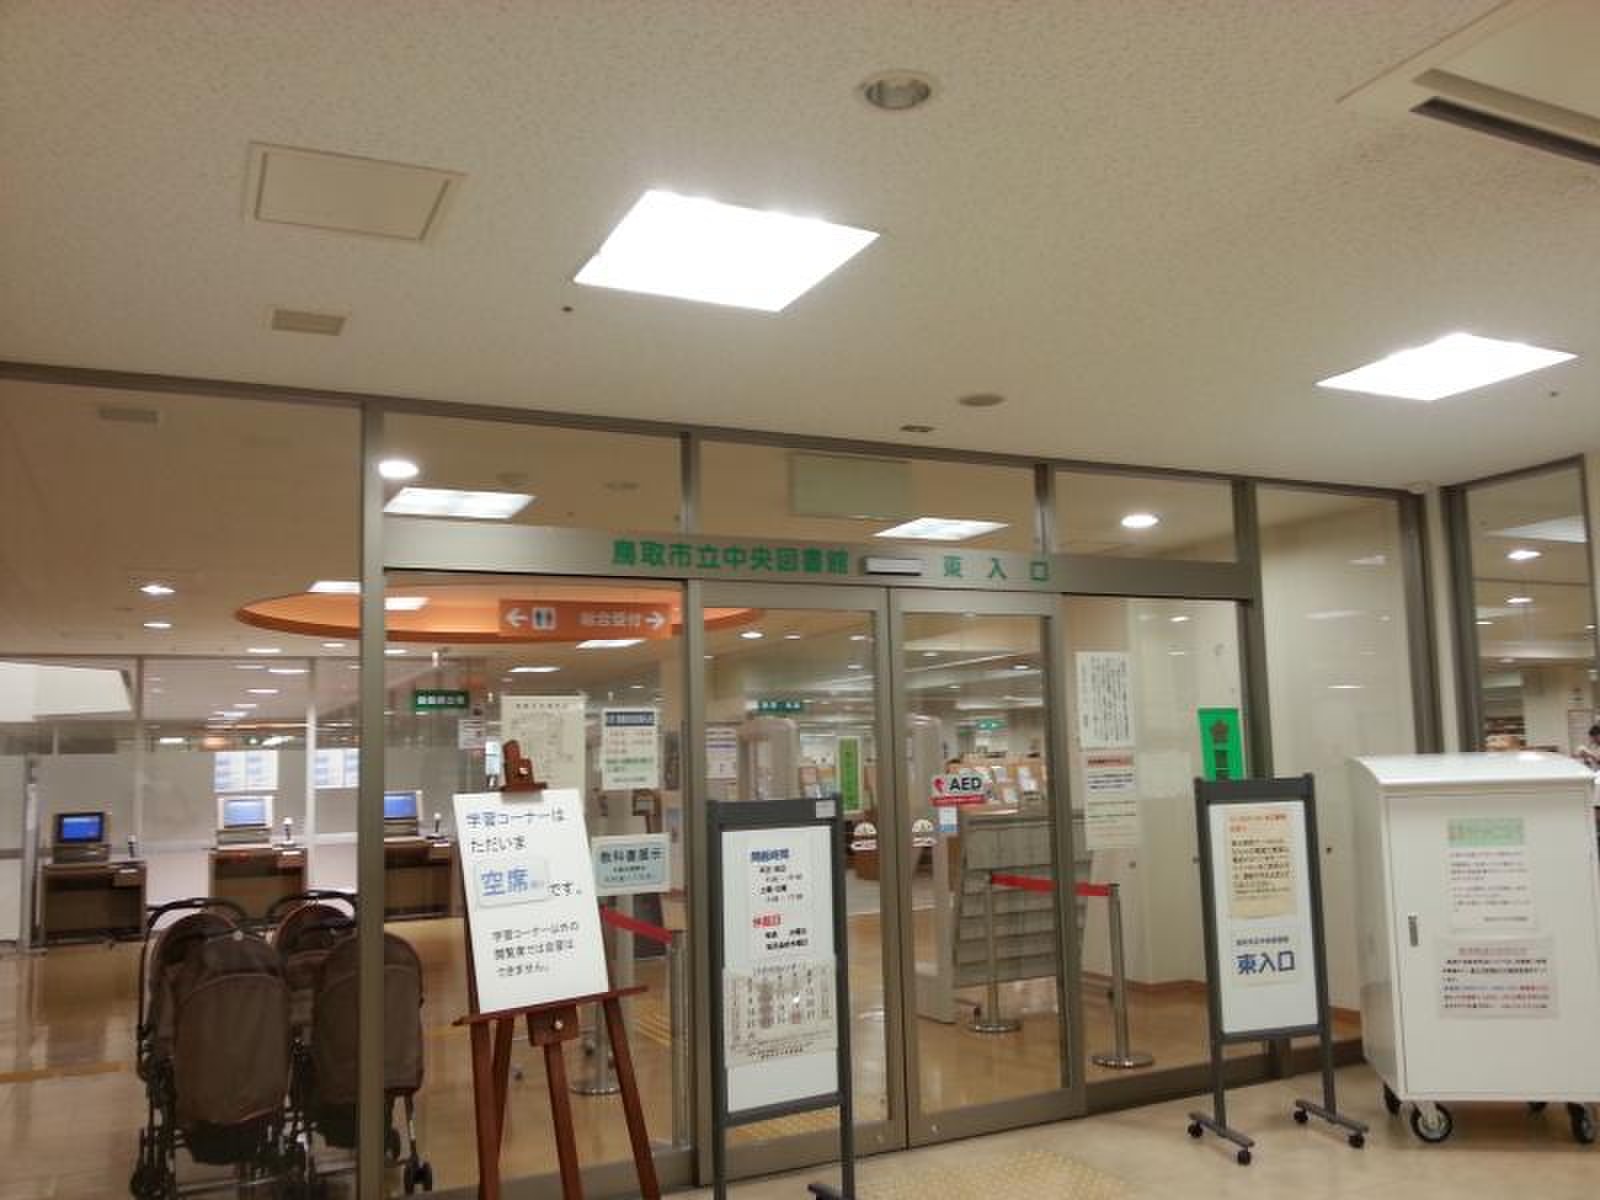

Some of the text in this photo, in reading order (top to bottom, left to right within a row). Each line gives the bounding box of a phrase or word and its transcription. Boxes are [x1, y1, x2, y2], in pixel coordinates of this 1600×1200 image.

[612, 540, 849, 575] 鳥取市立中央図書館
[949, 777, 982, 791] AED
[466, 806, 566, 828] 学習コーナーは
[471, 835, 527, 854] ただいま
[481, 867, 529, 897] 空席
[1236, 950, 1296, 975] 東入口
